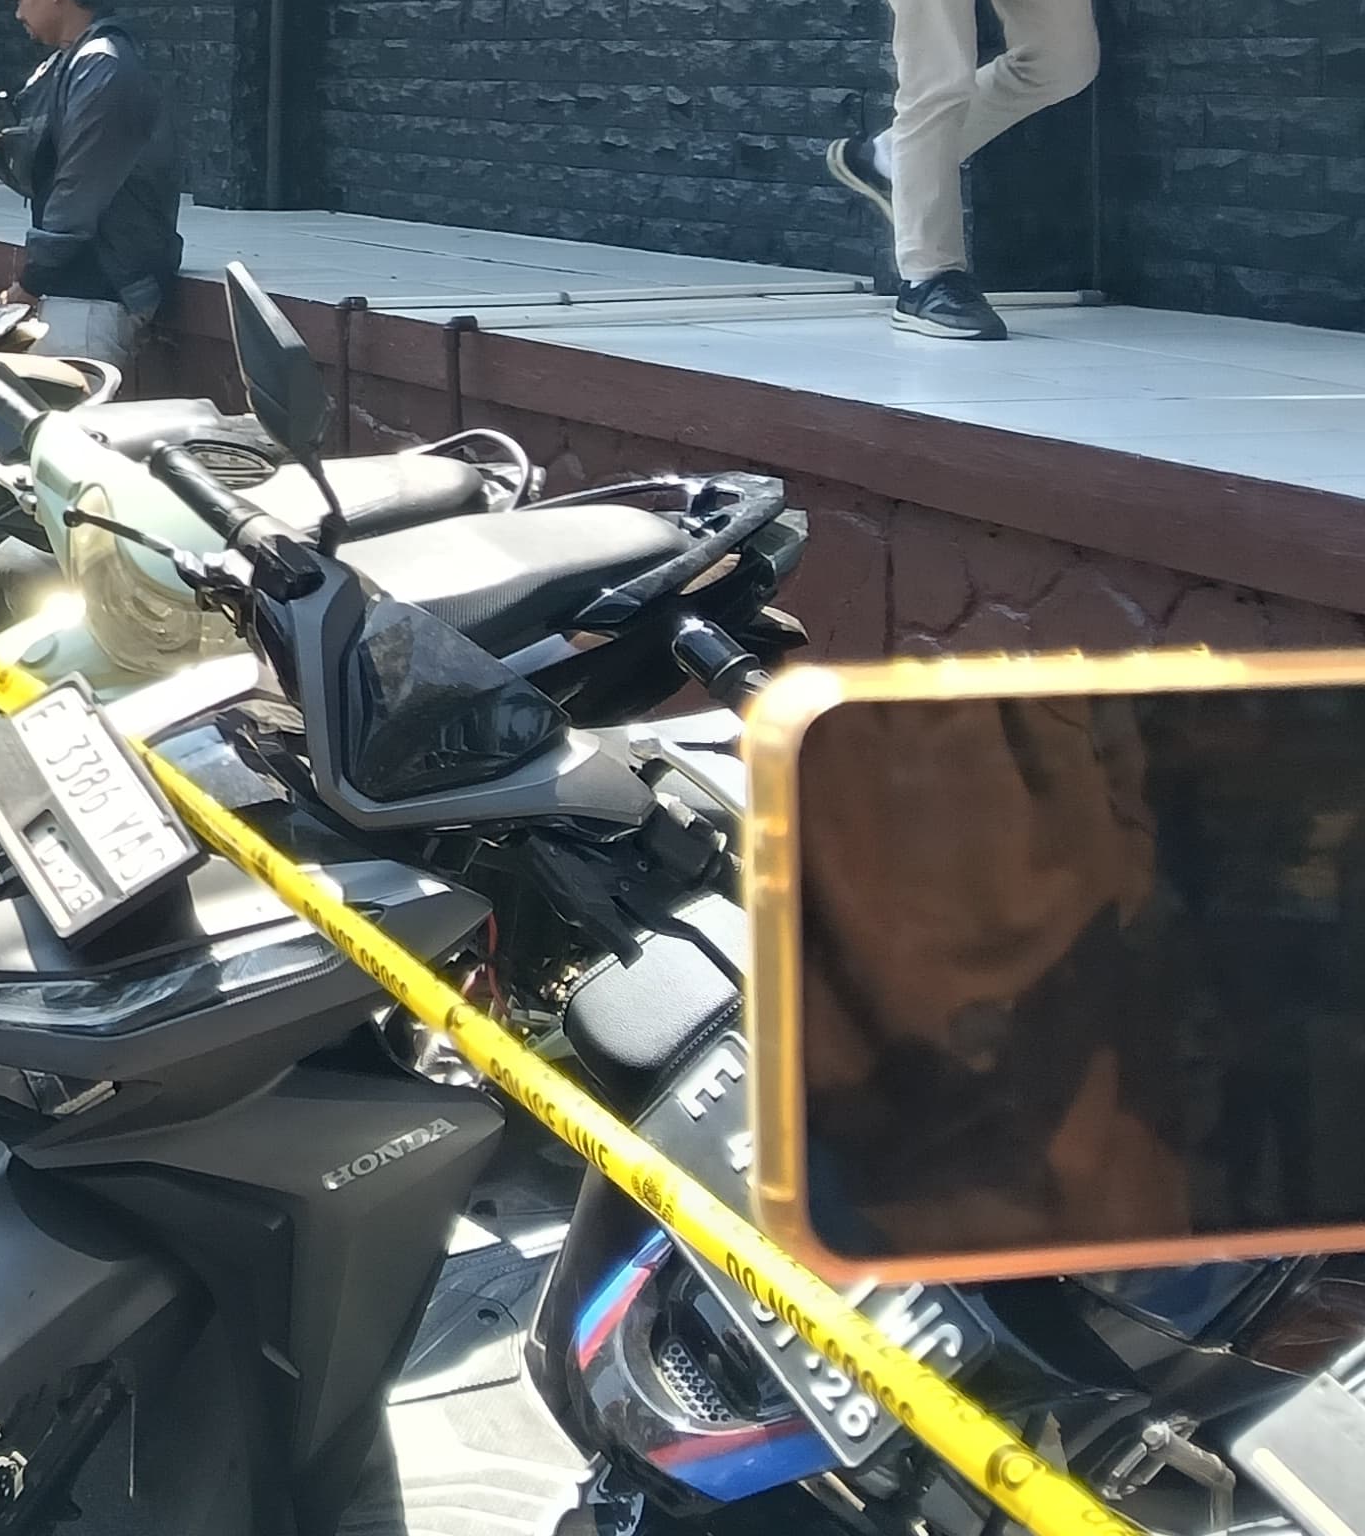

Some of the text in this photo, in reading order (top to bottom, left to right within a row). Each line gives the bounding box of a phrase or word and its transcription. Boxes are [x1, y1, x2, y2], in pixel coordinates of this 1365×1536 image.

[21, 700, 66, 732] E
[46, 734, 122, 814] 3386
[676, 1047, 746, 1120] E
[321, 1115, 459, 1191] HONDA
